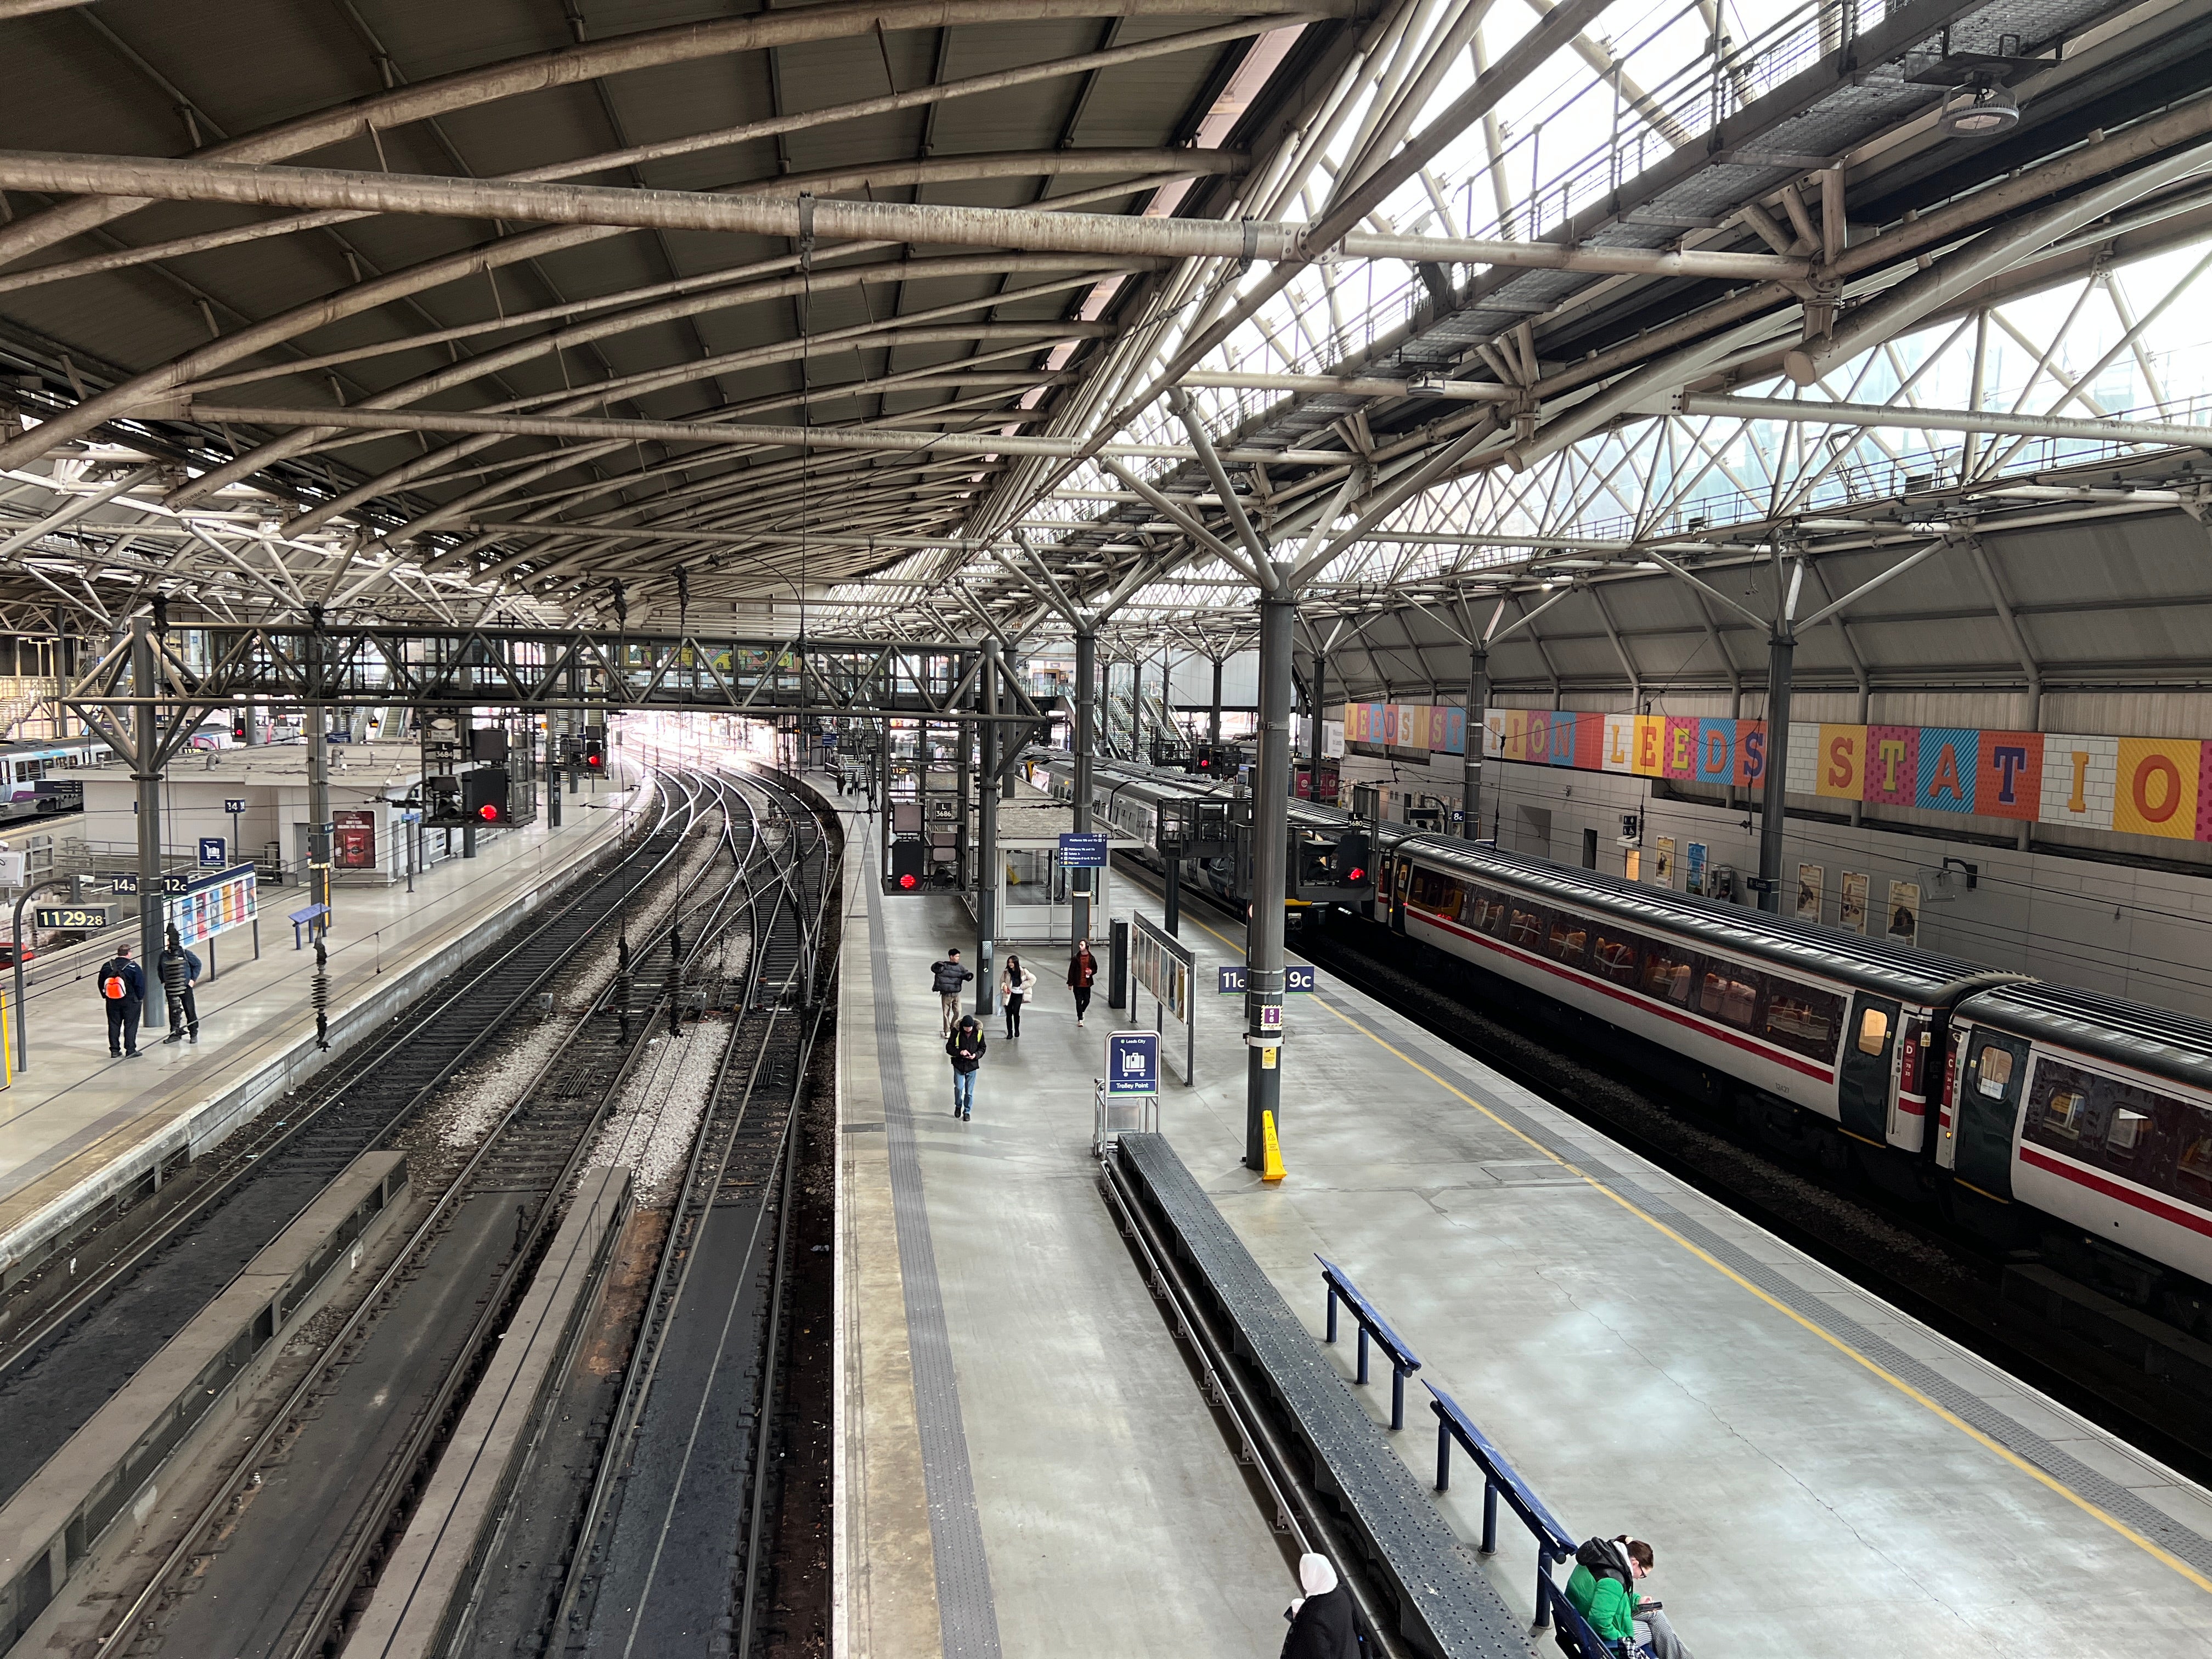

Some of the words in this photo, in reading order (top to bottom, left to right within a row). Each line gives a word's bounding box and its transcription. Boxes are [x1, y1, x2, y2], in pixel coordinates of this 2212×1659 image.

[1347, 709, 1410, 741] LEEDS
[1432, 713, 1571, 758] STTION
[1611, 724, 1765, 779] LEEDS
[1453, 812, 1463, 821] 8c
[112, 879, 137, 891] 14a
[164, 879, 187, 891] 12c
[1222, 972, 1245, 988] 11c
[1289, 971, 1311, 988] 9c
[1906, 1045, 1913, 1054] D
